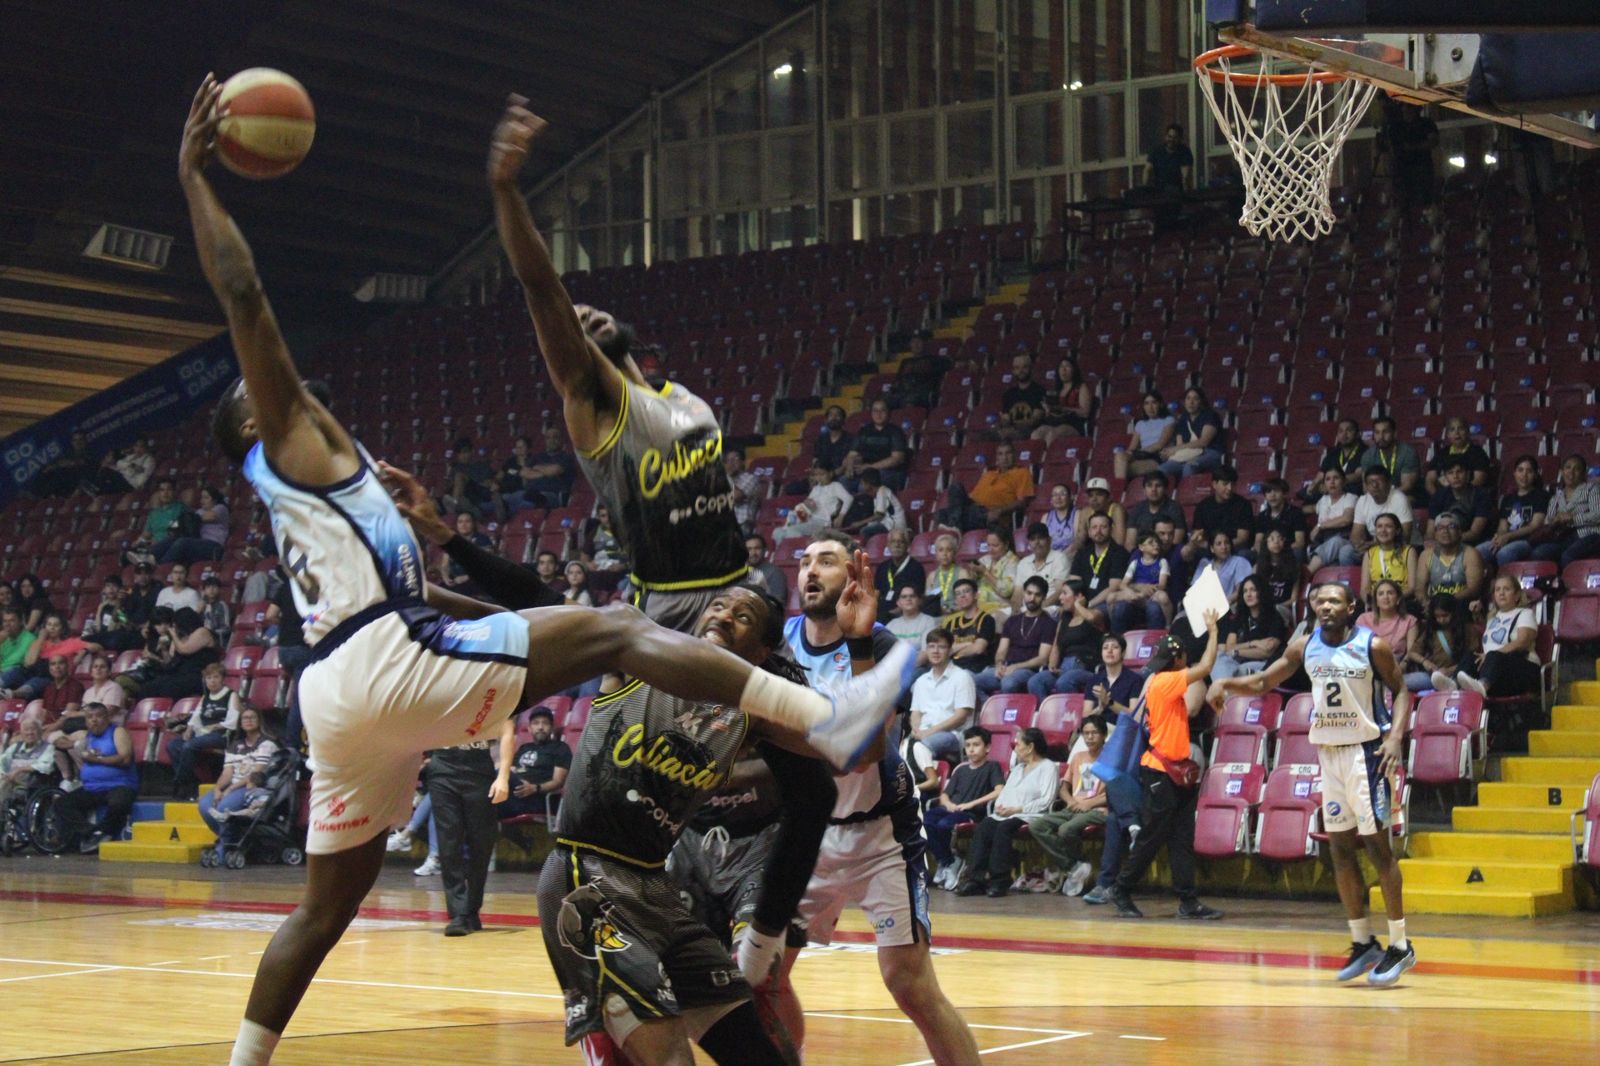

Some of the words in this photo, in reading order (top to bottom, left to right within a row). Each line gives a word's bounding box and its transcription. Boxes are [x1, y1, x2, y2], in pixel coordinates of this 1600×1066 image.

[179, 358, 206, 379] GO
[188, 359, 230, 396] CAVS
[4, 441, 35, 466] GO
[14, 441, 62, 483] CAVS
[1312, 665, 1367, 679] ASTROS
[1326, 682, 1342, 707] 2
[1548, 787, 1562, 805] B
[169, 827, 180, 841] A
[1466, 866, 1484, 883] A
